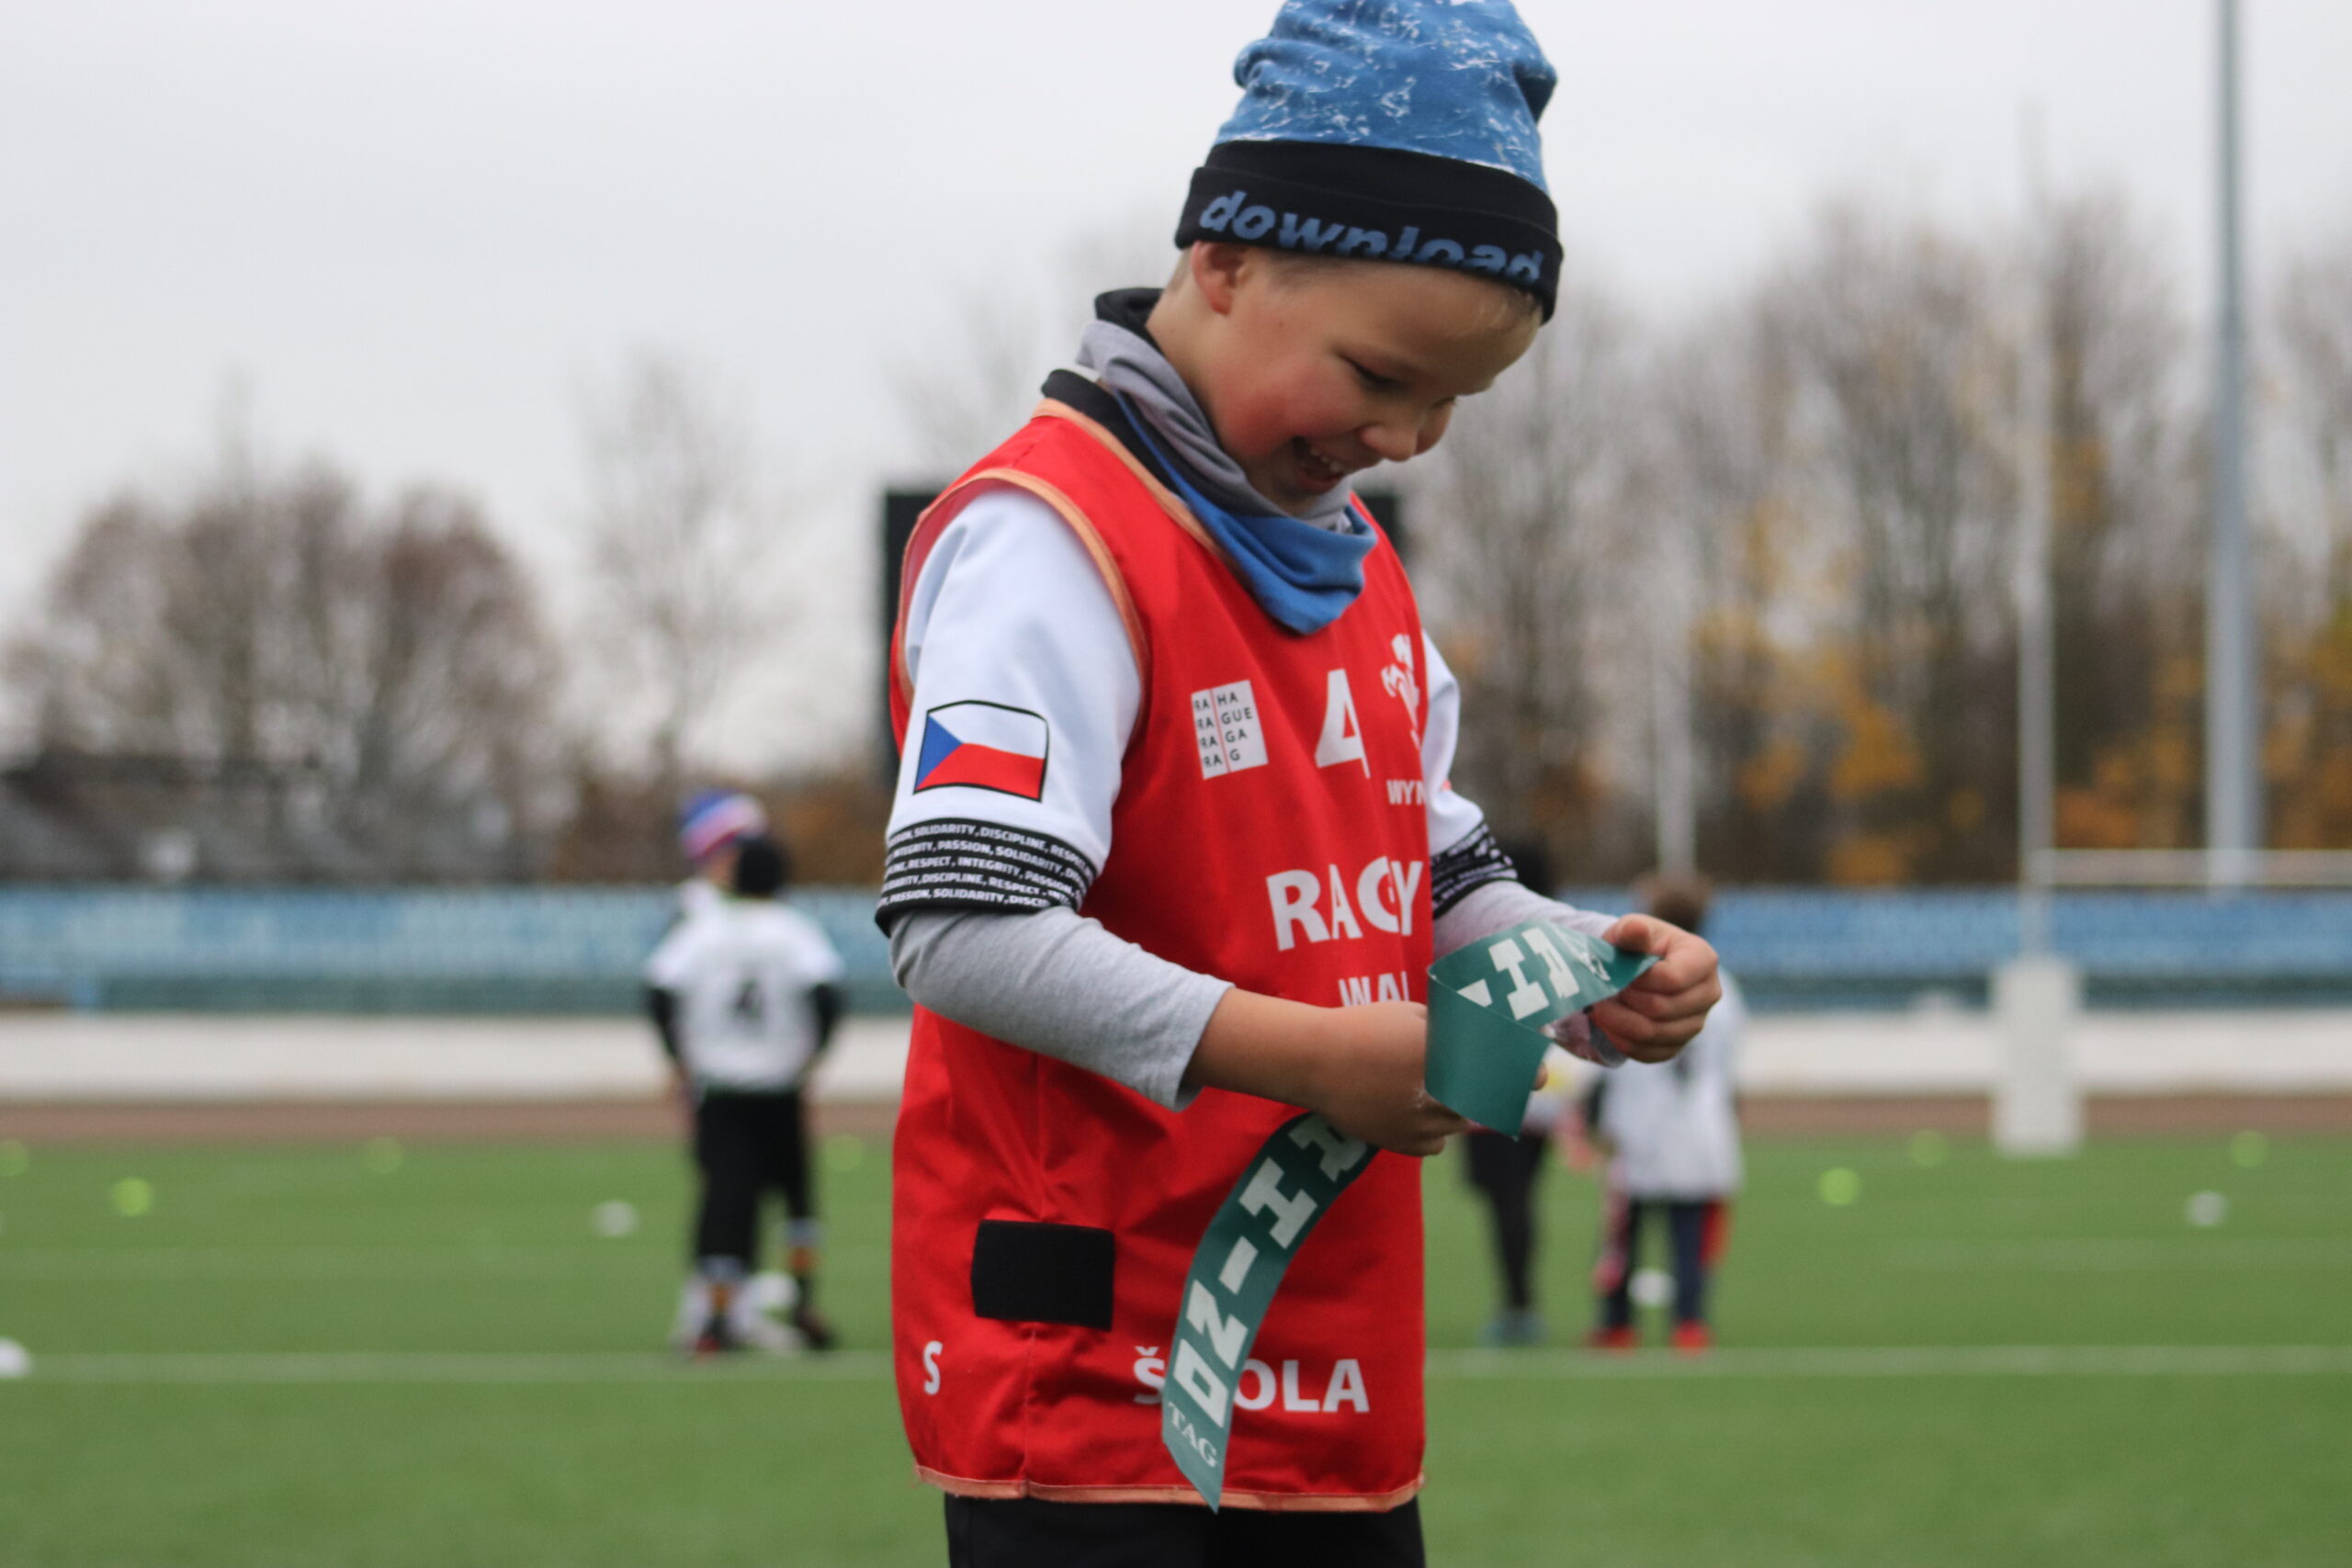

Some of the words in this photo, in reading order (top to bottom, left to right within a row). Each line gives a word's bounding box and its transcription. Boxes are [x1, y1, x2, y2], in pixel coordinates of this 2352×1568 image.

[1199, 190, 1544, 282] download
[1217, 691, 1238, 706] HA
[1221, 706, 1253, 725] GUE
[1225, 728, 1248, 743] GA
[1316, 669, 1370, 779] 4
[1229, 749, 1240, 761] G
[1133, 1346, 1370, 1413] ŠOLA
[1168, 1402, 1216, 1468] TAG
